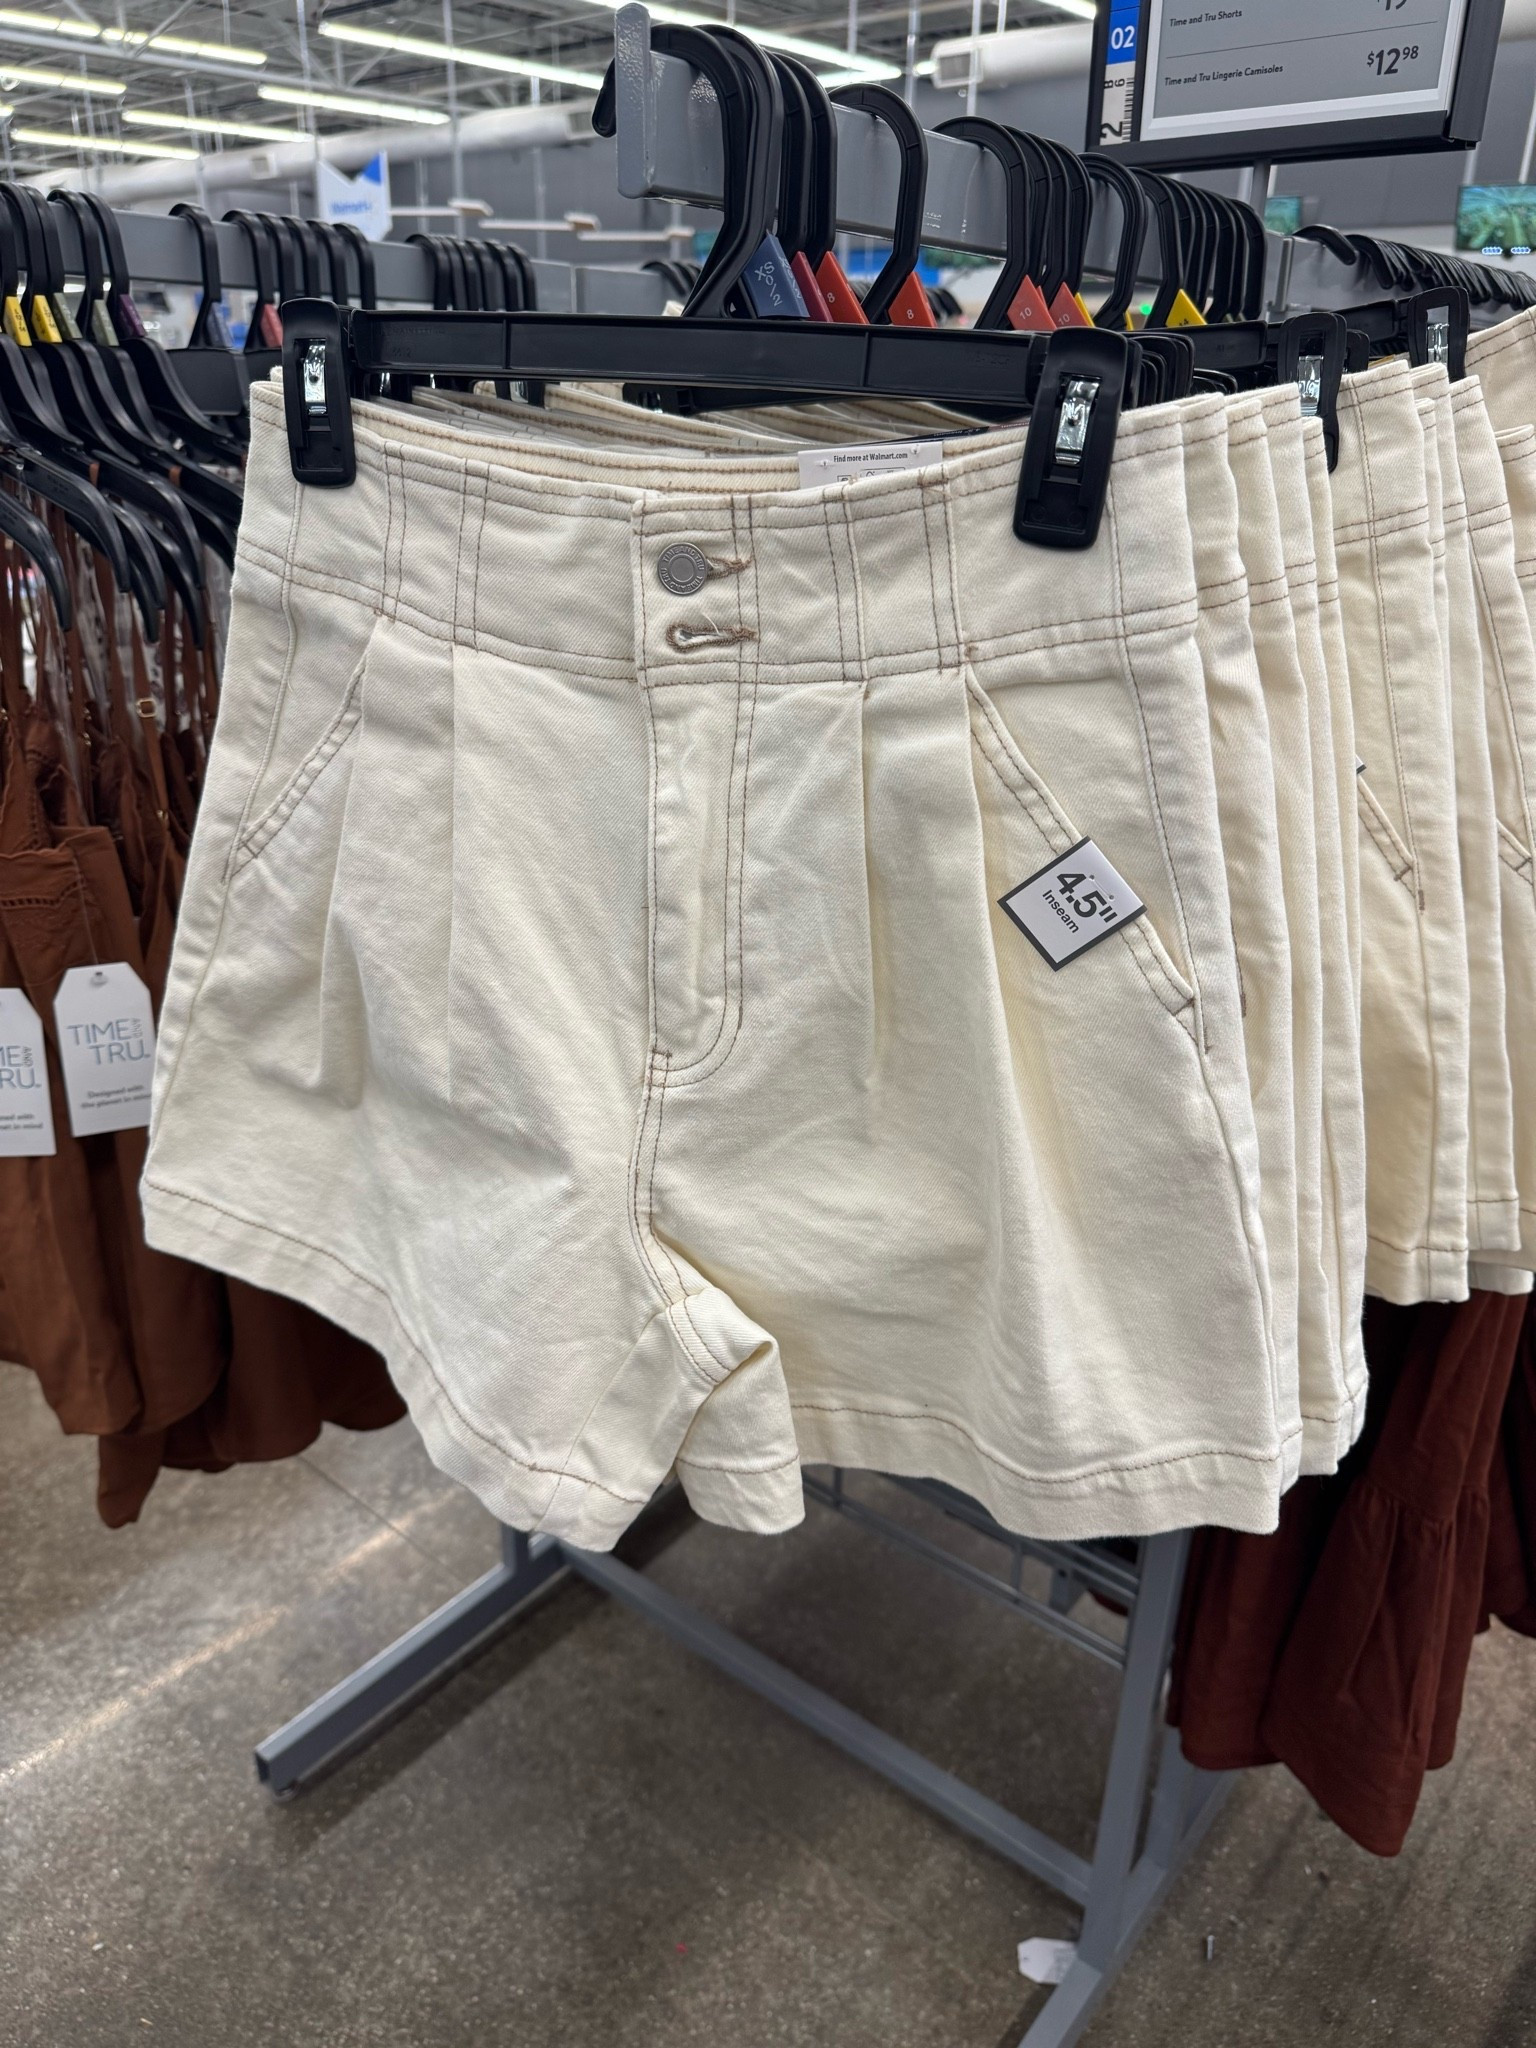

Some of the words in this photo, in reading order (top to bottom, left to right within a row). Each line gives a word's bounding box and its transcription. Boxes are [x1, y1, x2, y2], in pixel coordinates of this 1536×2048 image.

[1169, 18, 1187, 27] Time
[1189, 16, 1202, 24] and
[1205, 13, 1216, 22] Tru
[1218, 9, 1242, 20] Shorts
[1111, 25, 1135, 50] 02
[1164, 77, 1181, 86] Time
[1183, 74, 1197, 84] and
[1199, 72, 1211, 82] Tru
[1212, 69, 1243, 82] Lingerie
[1244, 65, 1284, 76] Camisoles
[754, 261, 775, 281] XS
[765, 275, 783, 307] 0/2
[826, 292, 836, 304] 8
[906, 309, 914, 320] 8
[1019, 307, 1033, 320] 10
[1058, 313, 1071, 326] 10
[833, 455, 847, 463] Find
[846, 455, 862, 463] more
[862, 454, 869, 462] at
[869, 452, 908, 461] Walmart.com
[1042, 889, 1080, 934] Inseam
[66, 1018, 130, 1046] TIME
